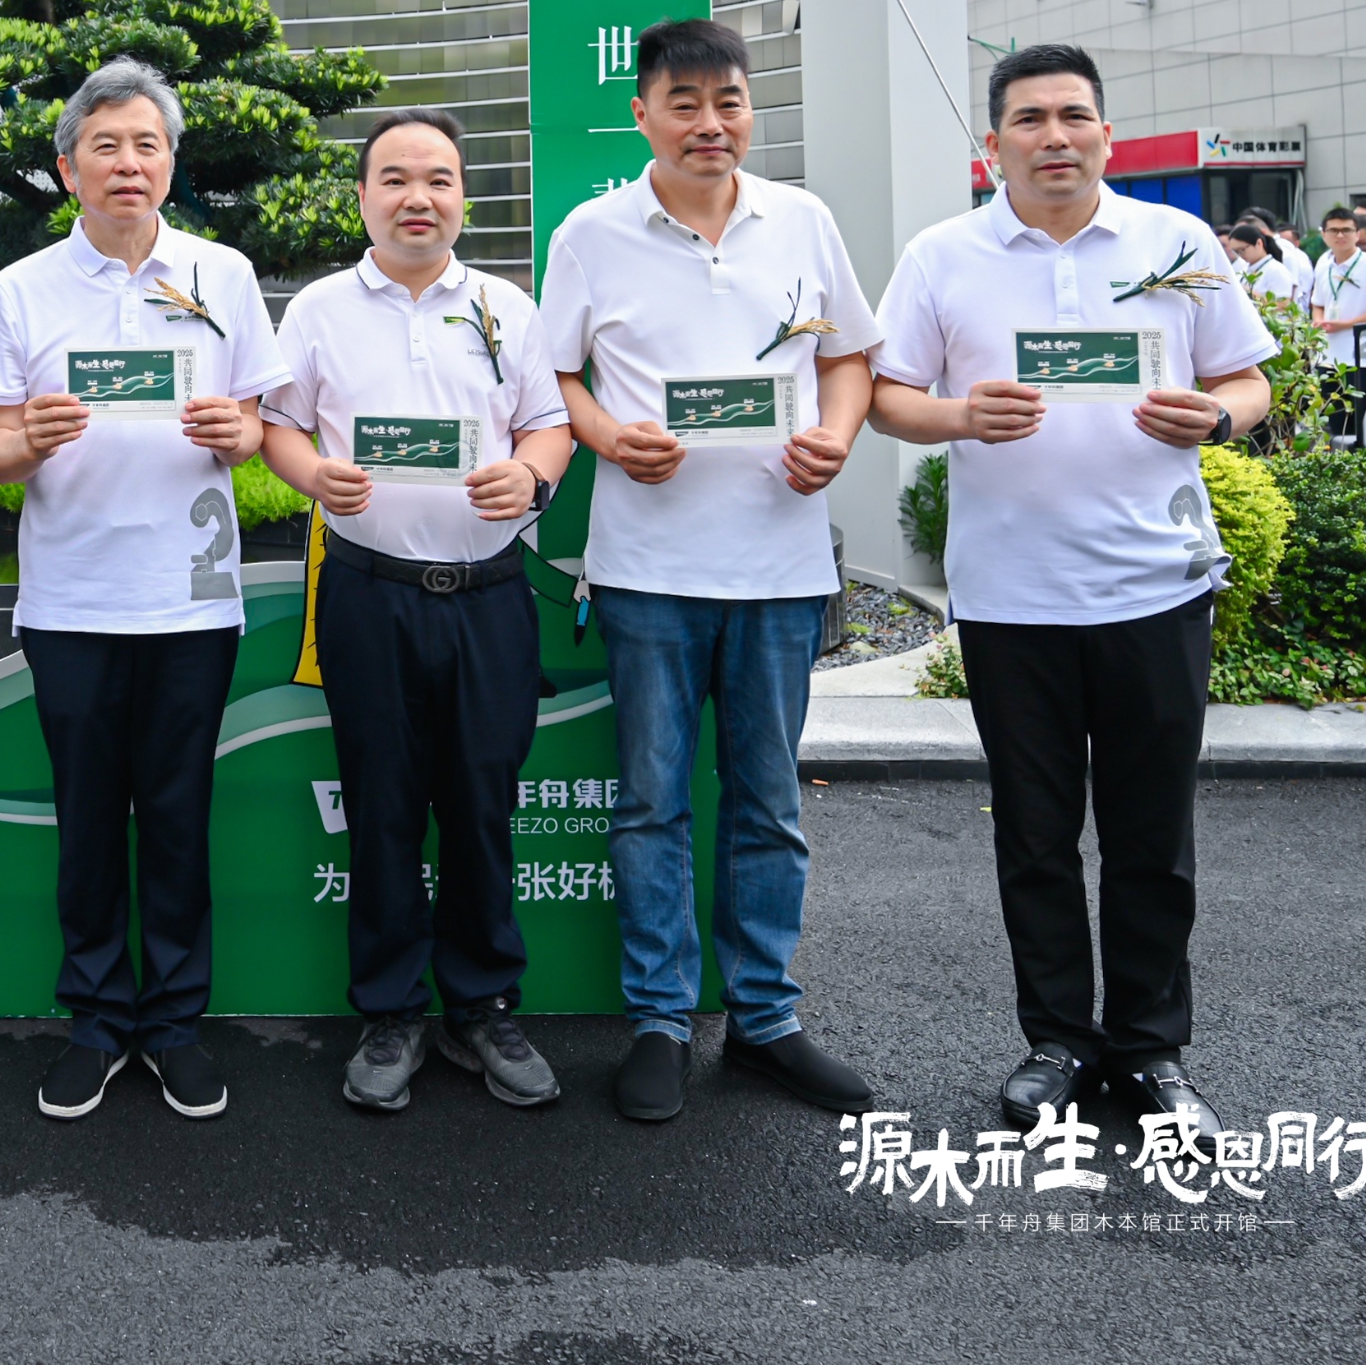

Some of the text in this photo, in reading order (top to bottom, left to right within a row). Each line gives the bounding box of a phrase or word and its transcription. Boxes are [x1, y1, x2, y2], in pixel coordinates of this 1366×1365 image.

[1232, 141, 1301, 153] 中国体育彩票
[510, 818, 611, 834] EEZO GRO
